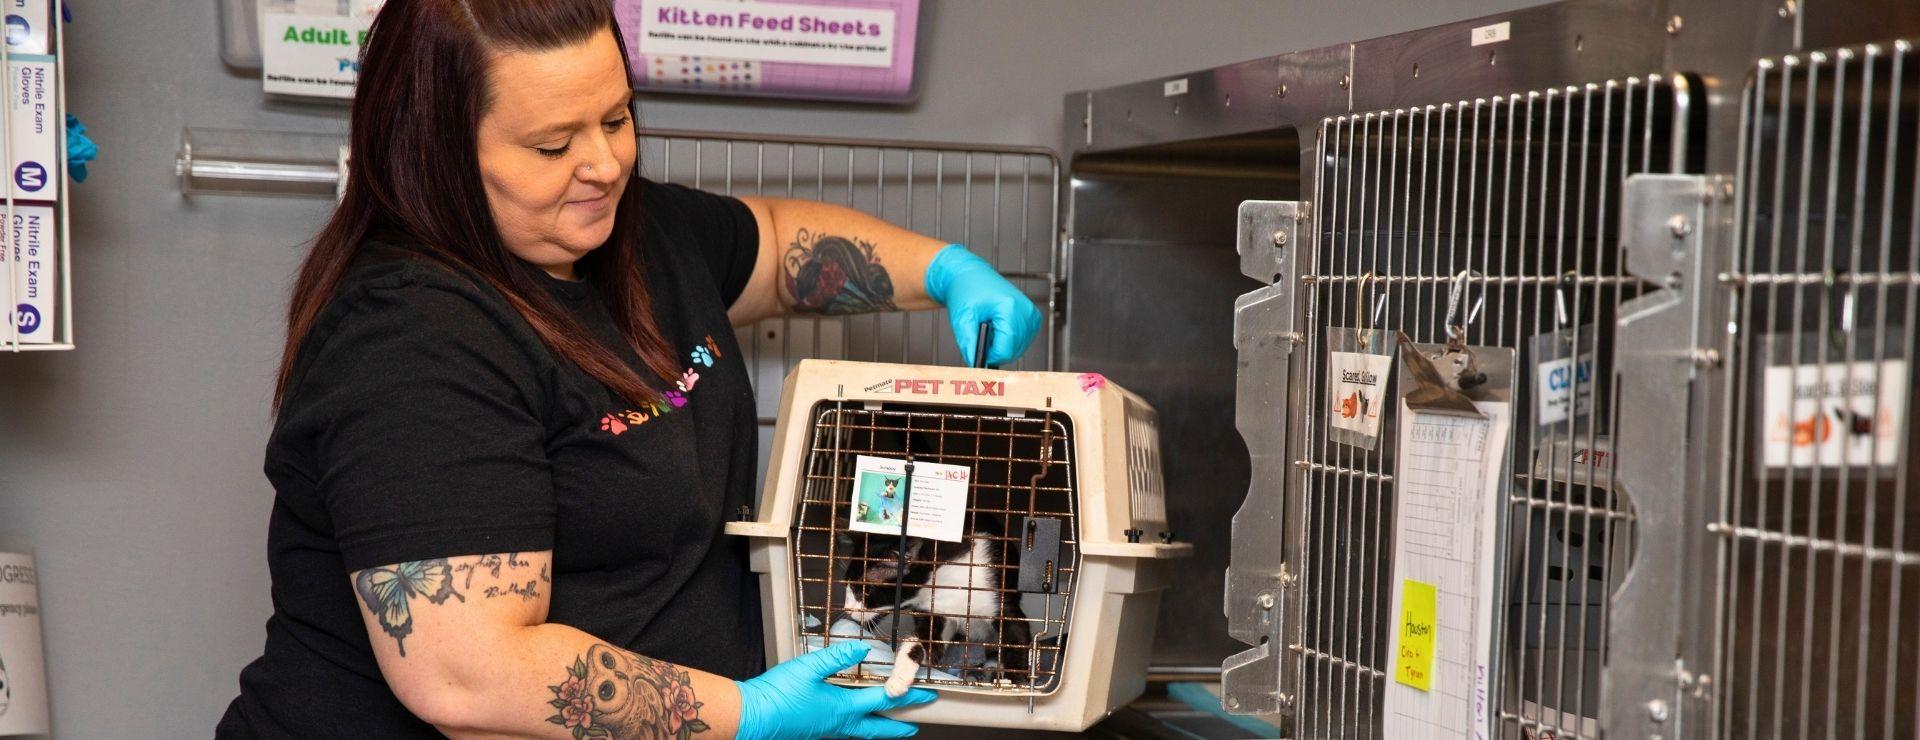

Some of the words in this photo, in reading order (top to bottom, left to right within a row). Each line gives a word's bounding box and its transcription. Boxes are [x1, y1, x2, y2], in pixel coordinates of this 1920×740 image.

[283, 25, 351, 46] Adult
[658, 6, 733, 27] Kitten
[738, 12, 793, 31] Feed
[799, 16, 880, 37] Sheets
[22, 67, 31, 105] Gloves
[35, 67, 44, 100] Nitrile
[35, 103, 44, 134] Exam
[21, 167, 41, 187] M
[28, 215, 40, 257] Nitrile
[28, 261, 40, 298] Exam
[18, 311, 36, 327] S
[864, 378, 893, 393] Petmate
[894, 378, 944, 395] PET
[950, 379, 1005, 396] TAXI
